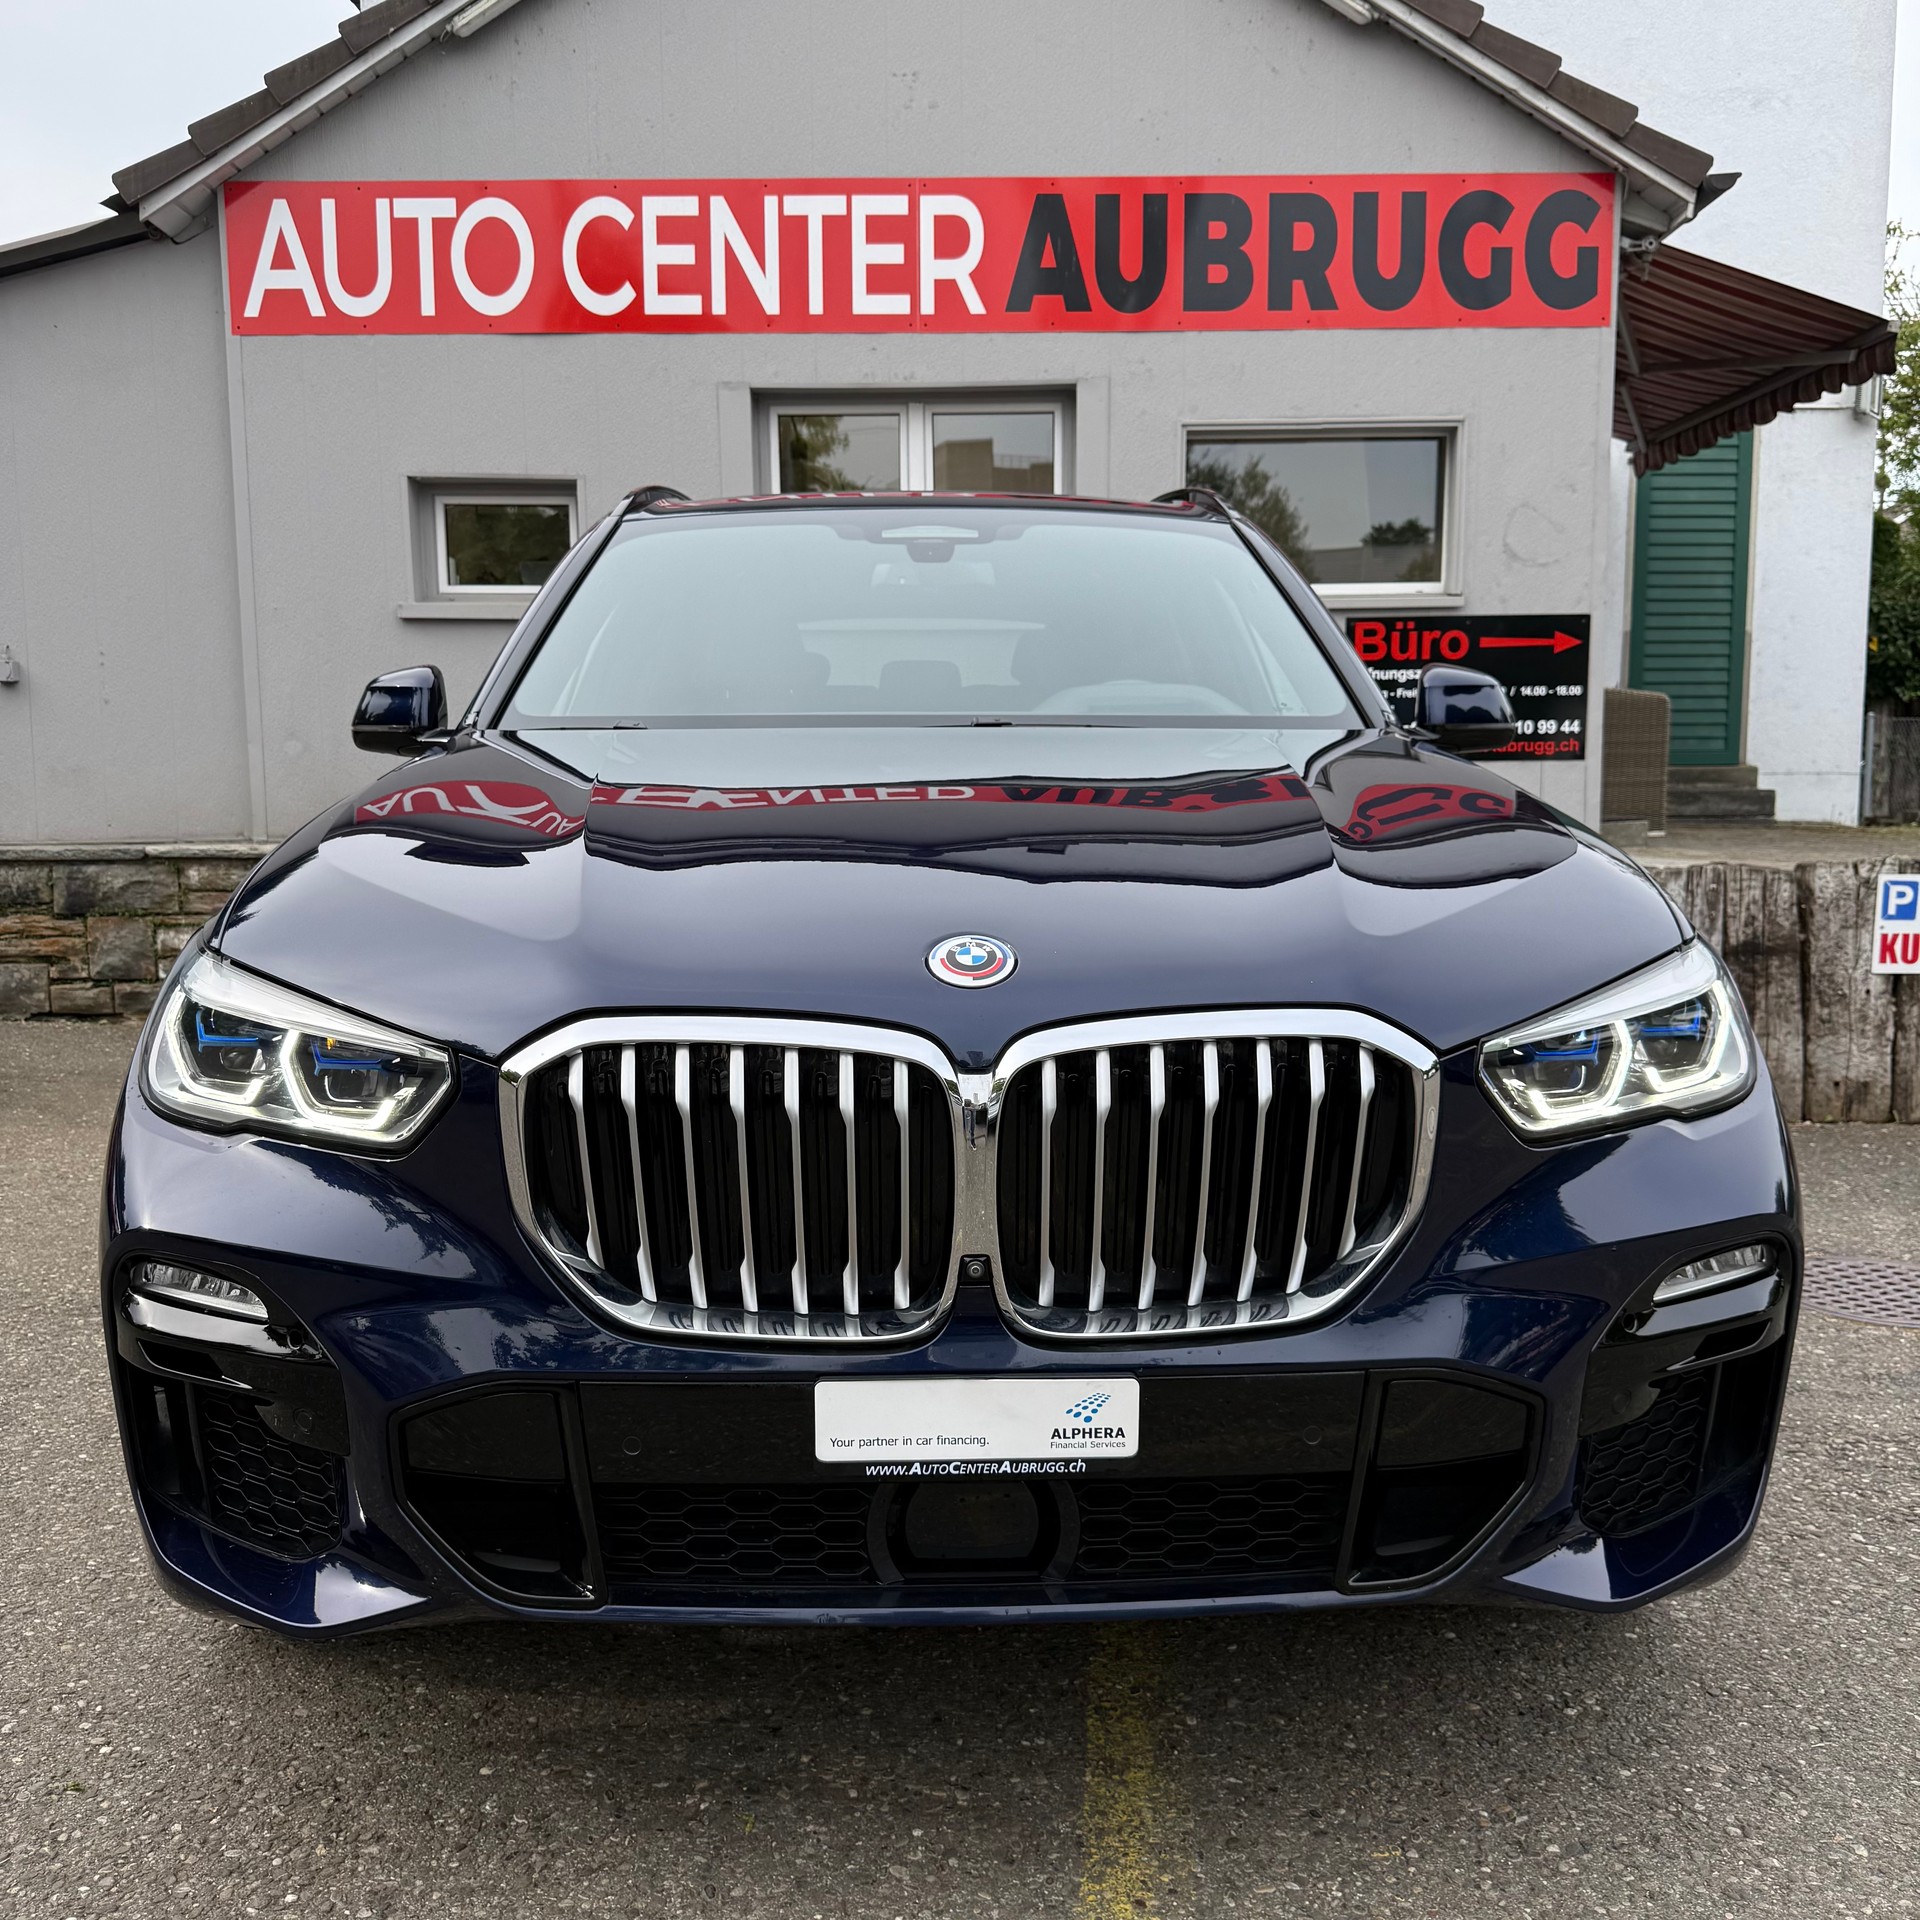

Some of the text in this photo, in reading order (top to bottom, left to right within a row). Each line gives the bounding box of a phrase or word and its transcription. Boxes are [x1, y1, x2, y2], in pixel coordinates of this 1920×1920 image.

[244, 189, 1602, 318] AUTO CENTER AUBRUGG
[1354, 621, 1470, 661] Büro
[1520, 685, 1548, 697] 14.00
[1556, 685, 1584, 696] 18.00
[1537, 719, 1558, 735] 99
[1560, 719, 1582, 735] 44
[1887, 884, 1915, 916] P
[950, 941, 993, 953] BMW
[1878, 933, 1920, 965] KU
[1050, 1427, 1126, 1440] ALPHERA
[829, 1434, 990, 1449] Your partner in car financing.
[1050, 1440, 1126, 1449] Financial Services
